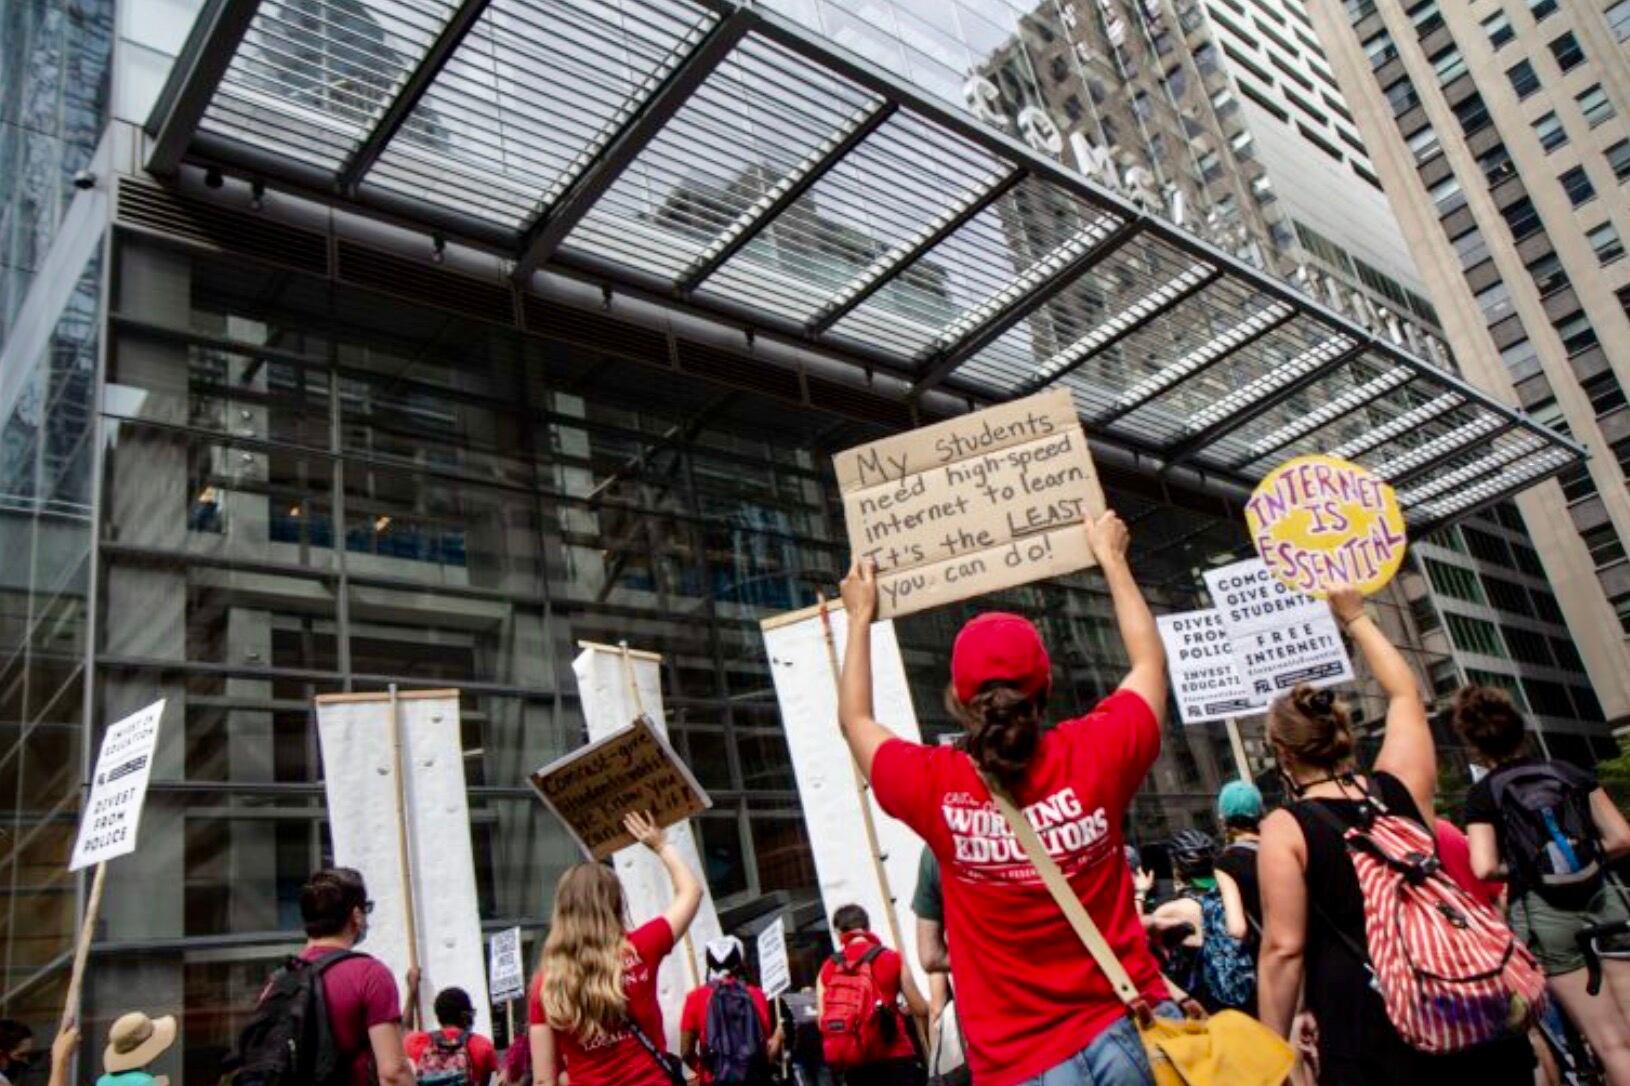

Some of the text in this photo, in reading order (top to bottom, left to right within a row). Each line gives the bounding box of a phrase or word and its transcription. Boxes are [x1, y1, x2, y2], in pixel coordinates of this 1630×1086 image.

[856, 448, 907, 487] My
[860, 435, 1072, 514] need high-speed
[1250, 465, 1384, 527] INTERNET
[864, 499, 968, 543] internet
[983, 485, 1013, 504] to
[1304, 501, 1348, 533] IS
[863, 499, 1084, 572] It's the LEAST
[1258, 515, 1402, 589] ESSENTIAL
[882, 534, 1053, 608] you can do!
[1218, 570, 1273, 591] COMC
[1227, 587, 1268, 605] GIVE
[1173, 614, 1222, 632] DIVES
[1179, 642, 1232, 660] POLIC
[1246, 636, 1332, 665] INTERNET!
[1182, 675, 1240, 692] EDUCATI
[1184, 666, 1231, 680] INVEST
[94, 787, 136, 815] DIVEST
[941, 787, 1082, 835] WORING
[94, 811, 125, 831] FROM
[952, 807, 1109, 863] EDUCTORS
[83, 827, 127, 854] POLICE
